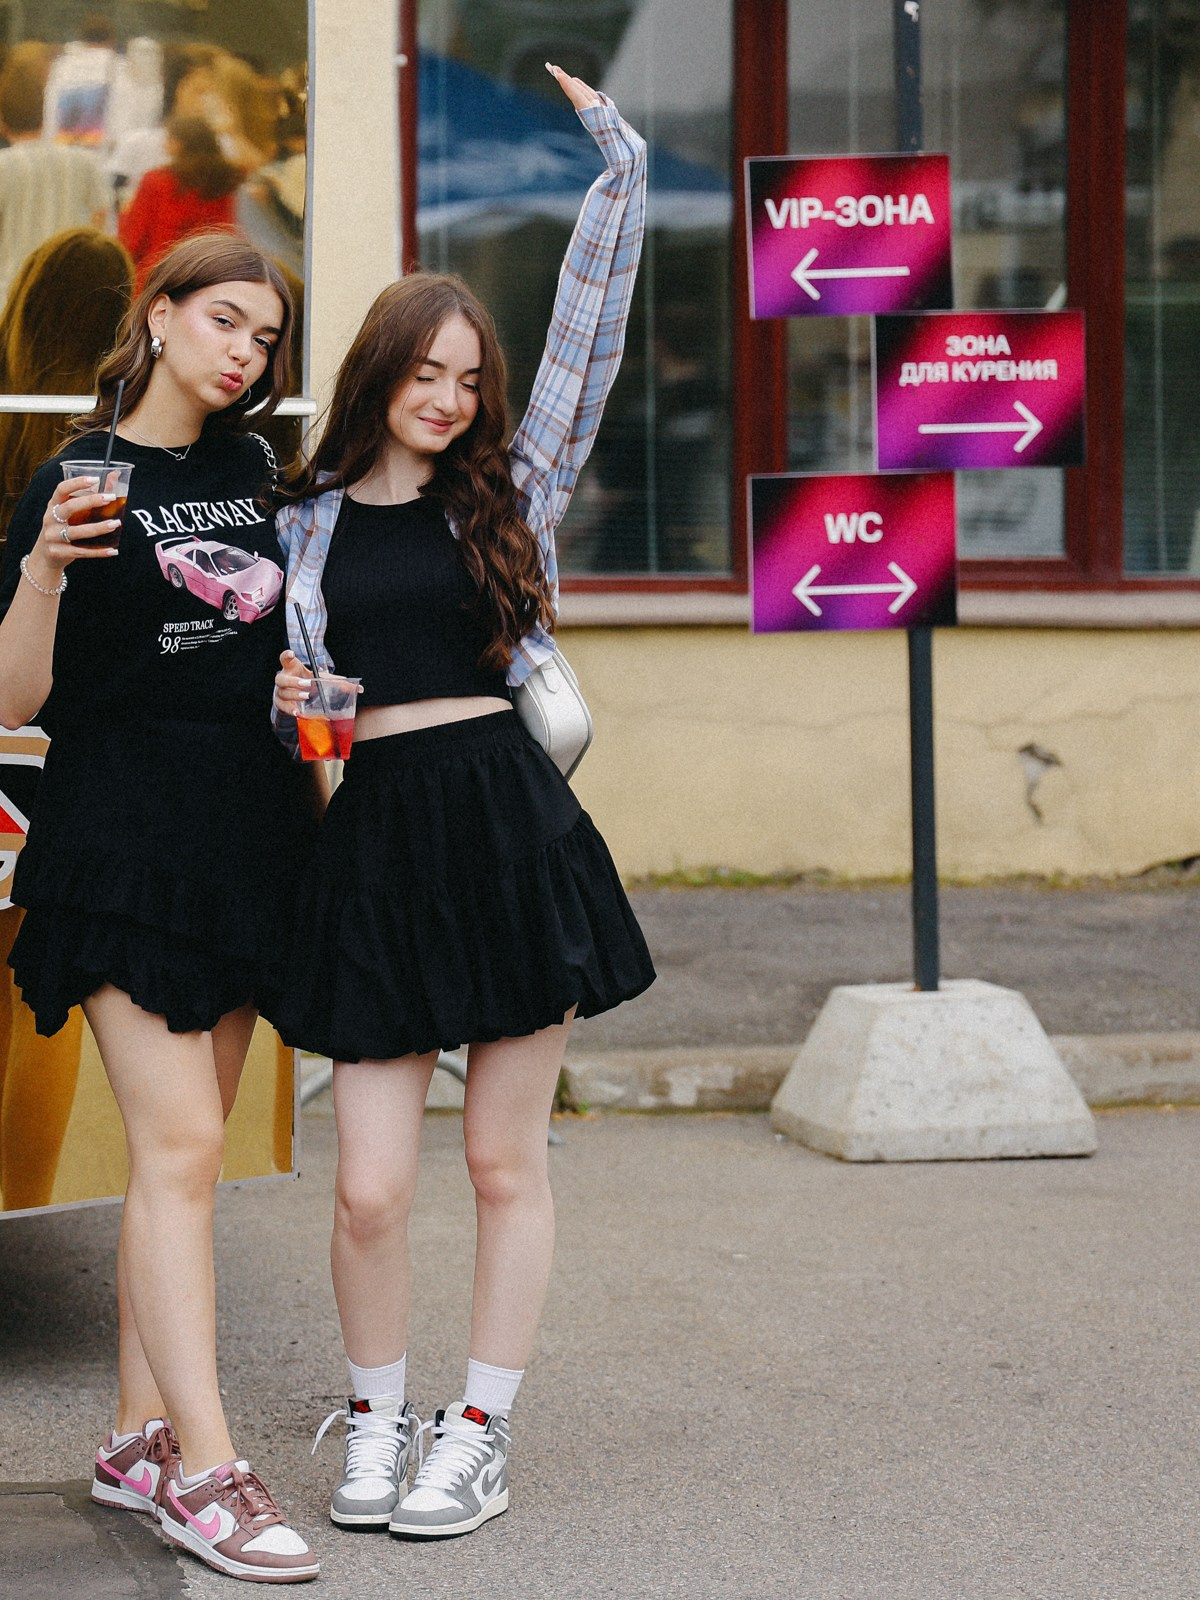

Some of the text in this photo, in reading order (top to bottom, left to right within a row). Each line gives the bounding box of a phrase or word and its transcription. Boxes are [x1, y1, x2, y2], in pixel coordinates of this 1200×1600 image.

[764, 193, 936, 229] VIP-ЗОНА
[944, 334, 1012, 357] ЗОНА
[899, 359, 1058, 387] ДЛЯ КУРЕНИЯ
[131, 499, 266, 537] RACEWAY
[823, 511, 884, 545] WC
[162, 619, 215, 633] SPEED TRACK
